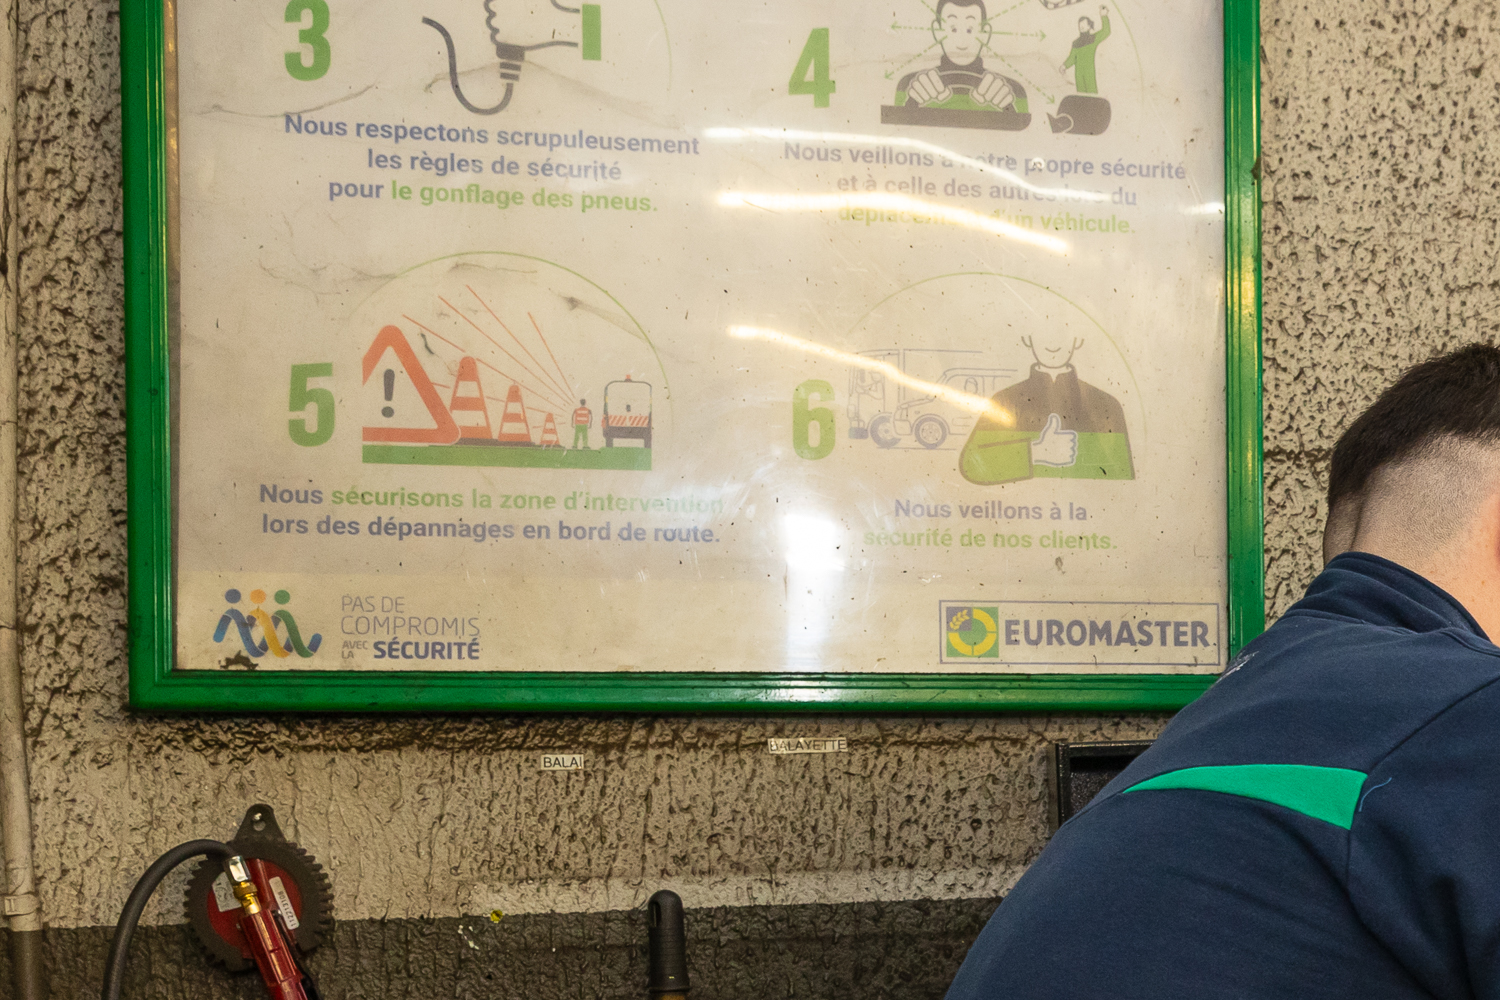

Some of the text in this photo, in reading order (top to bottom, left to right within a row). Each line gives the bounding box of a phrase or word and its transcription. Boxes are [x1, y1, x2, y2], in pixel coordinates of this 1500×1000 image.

[284, 0, 331, 81] 3
[788, 27, 836, 108] 4
[285, 114, 700, 155] Nous respectons scrupuleusement
[368, 148, 622, 180] les règles de sécurité
[784, 142, 842, 162] Nous
[849, 145, 934, 167] veillons
[1101, 158, 1186, 179] sécurité
[329, 180, 658, 213] pour le gonflage des pneus.
[837, 175, 858, 192] et
[865, 173, 878, 192] à
[884, 176, 936, 195] celle
[943, 178, 982, 197] des
[1112, 186, 1137, 206] du
[1041, 211, 1135, 233] véhicule.
[288, 363, 335, 447] 5
[792, 379, 835, 460] 6
[260, 484, 323, 504] Nous
[332, 485, 463, 507] sécurisons
[472, 488, 492, 508] la
[501, 493, 556, 510] zone
[895, 499, 1087, 520] Nous veillons à la
[263, 513, 720, 542] lors des dépannages en bord de route.
[863, 527, 1118, 550] sécurité de nos clients.
[341, 595, 405, 613] PAS DE
[341, 615, 480, 636] COMPROMIS
[1005, 619, 1210, 647] EUROMASTER
[341, 651, 354, 660] LA
[342, 640, 368, 650] AVEC
[373, 636, 480, 660] SÉCURITÉ
[543, 757, 582, 769] BALAI
